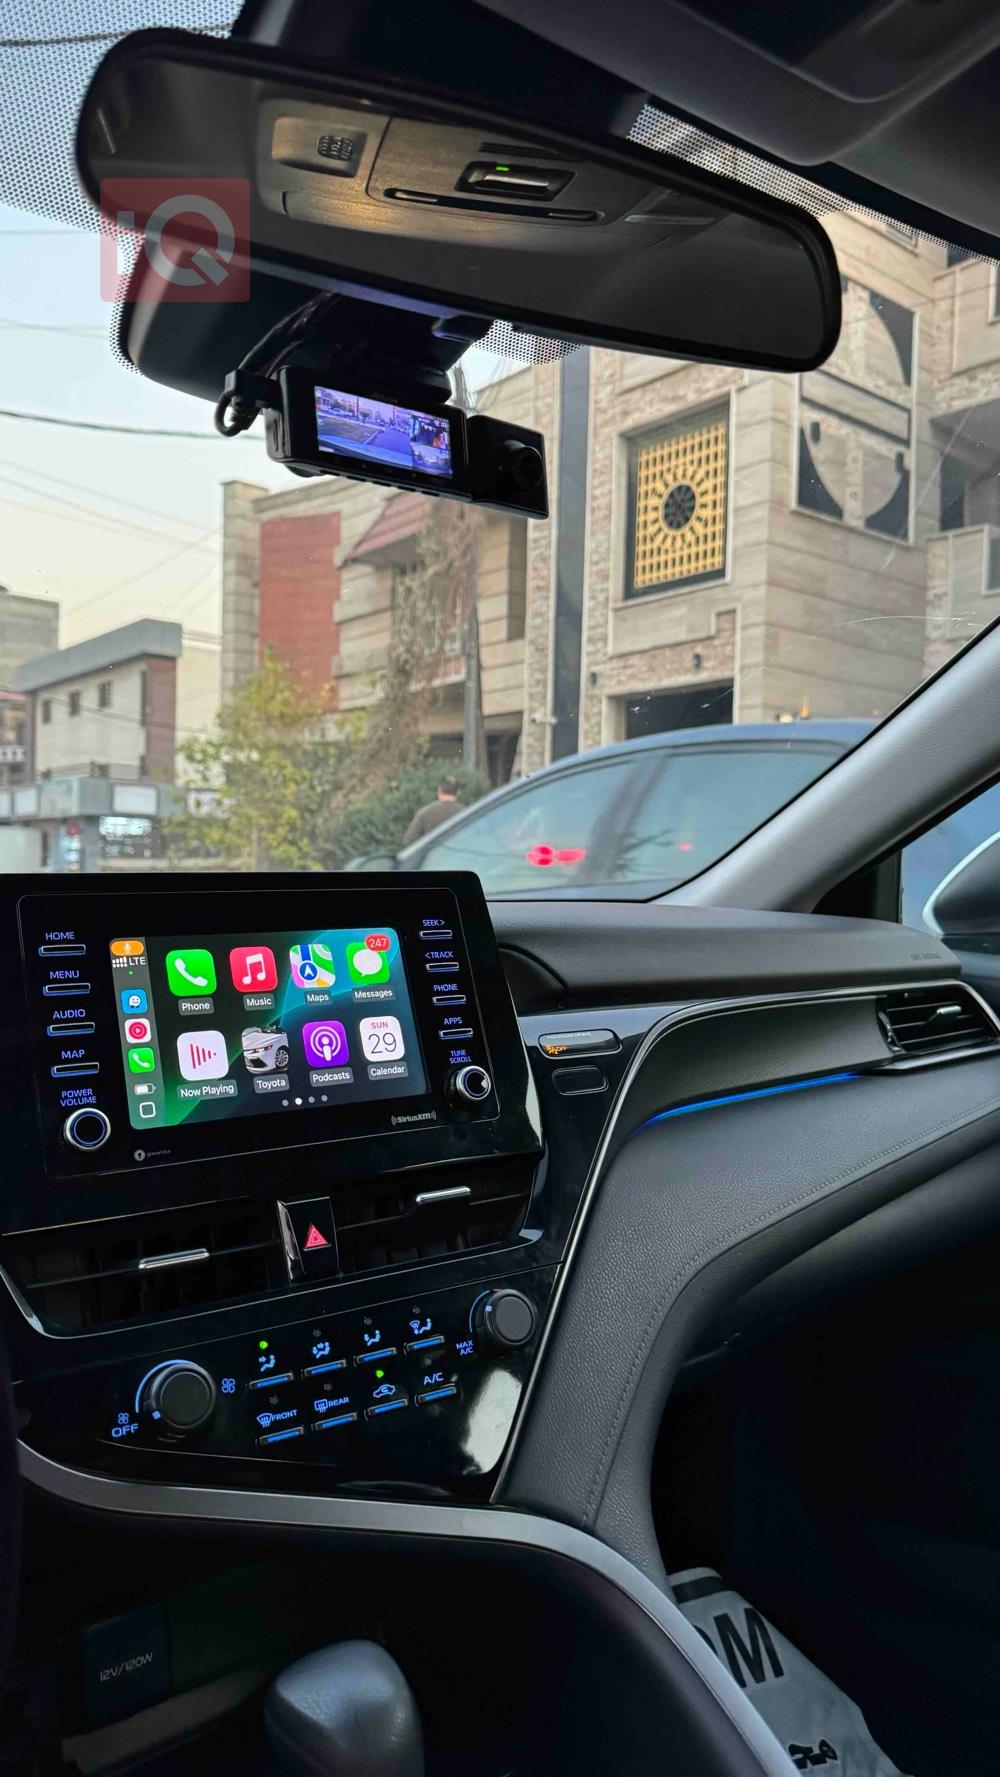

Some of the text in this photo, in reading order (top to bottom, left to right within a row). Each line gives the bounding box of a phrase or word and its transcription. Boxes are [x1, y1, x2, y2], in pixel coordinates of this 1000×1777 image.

[45, 931, 75, 940] HOME
[370, 938, 388, 948] 247
[129, 957, 146, 966] LTE
[49, 970, 80, 979] MENU
[433, 983, 458, 991] PHONE
[307, 993, 329, 1003] Maps
[354, 989, 393, 1000] Messages
[182, 1001, 210, 1011] Phone
[246, 997, 272, 1007] Music
[52, 1009, 86, 1019] AUDIO
[371, 1021, 389, 1029] SUN
[443, 1017, 463, 1025] APPS
[368, 1033, 397, 1054] 29
[61, 1050, 85, 1059] MAP
[450, 1049, 467, 1057] TUNE
[449, 1055, 472, 1064] SCROLL
[370, 1065, 405, 1076] Calendar
[312, 1070, 351, 1082] Podcasts
[257, 1078, 286, 1090] Toyota
[61, 1088, 94, 1098] POWER
[180, 1083, 235, 1097] Now Playing
[60, 1096, 97, 1107] VOLUME
[456, 1340, 474, 1350] MAX
[459, 1346, 474, 1356] A/C
[423, 1371, 445, 1386] A/C
[328, 1396, 350, 1408] REAR
[271, 1408, 299, 1422] FRONT
[111, 1422, 139, 1438] OFF
[693, 1607, 784, 1688] M
[99, 1651, 153, 1682] 12V/120W
